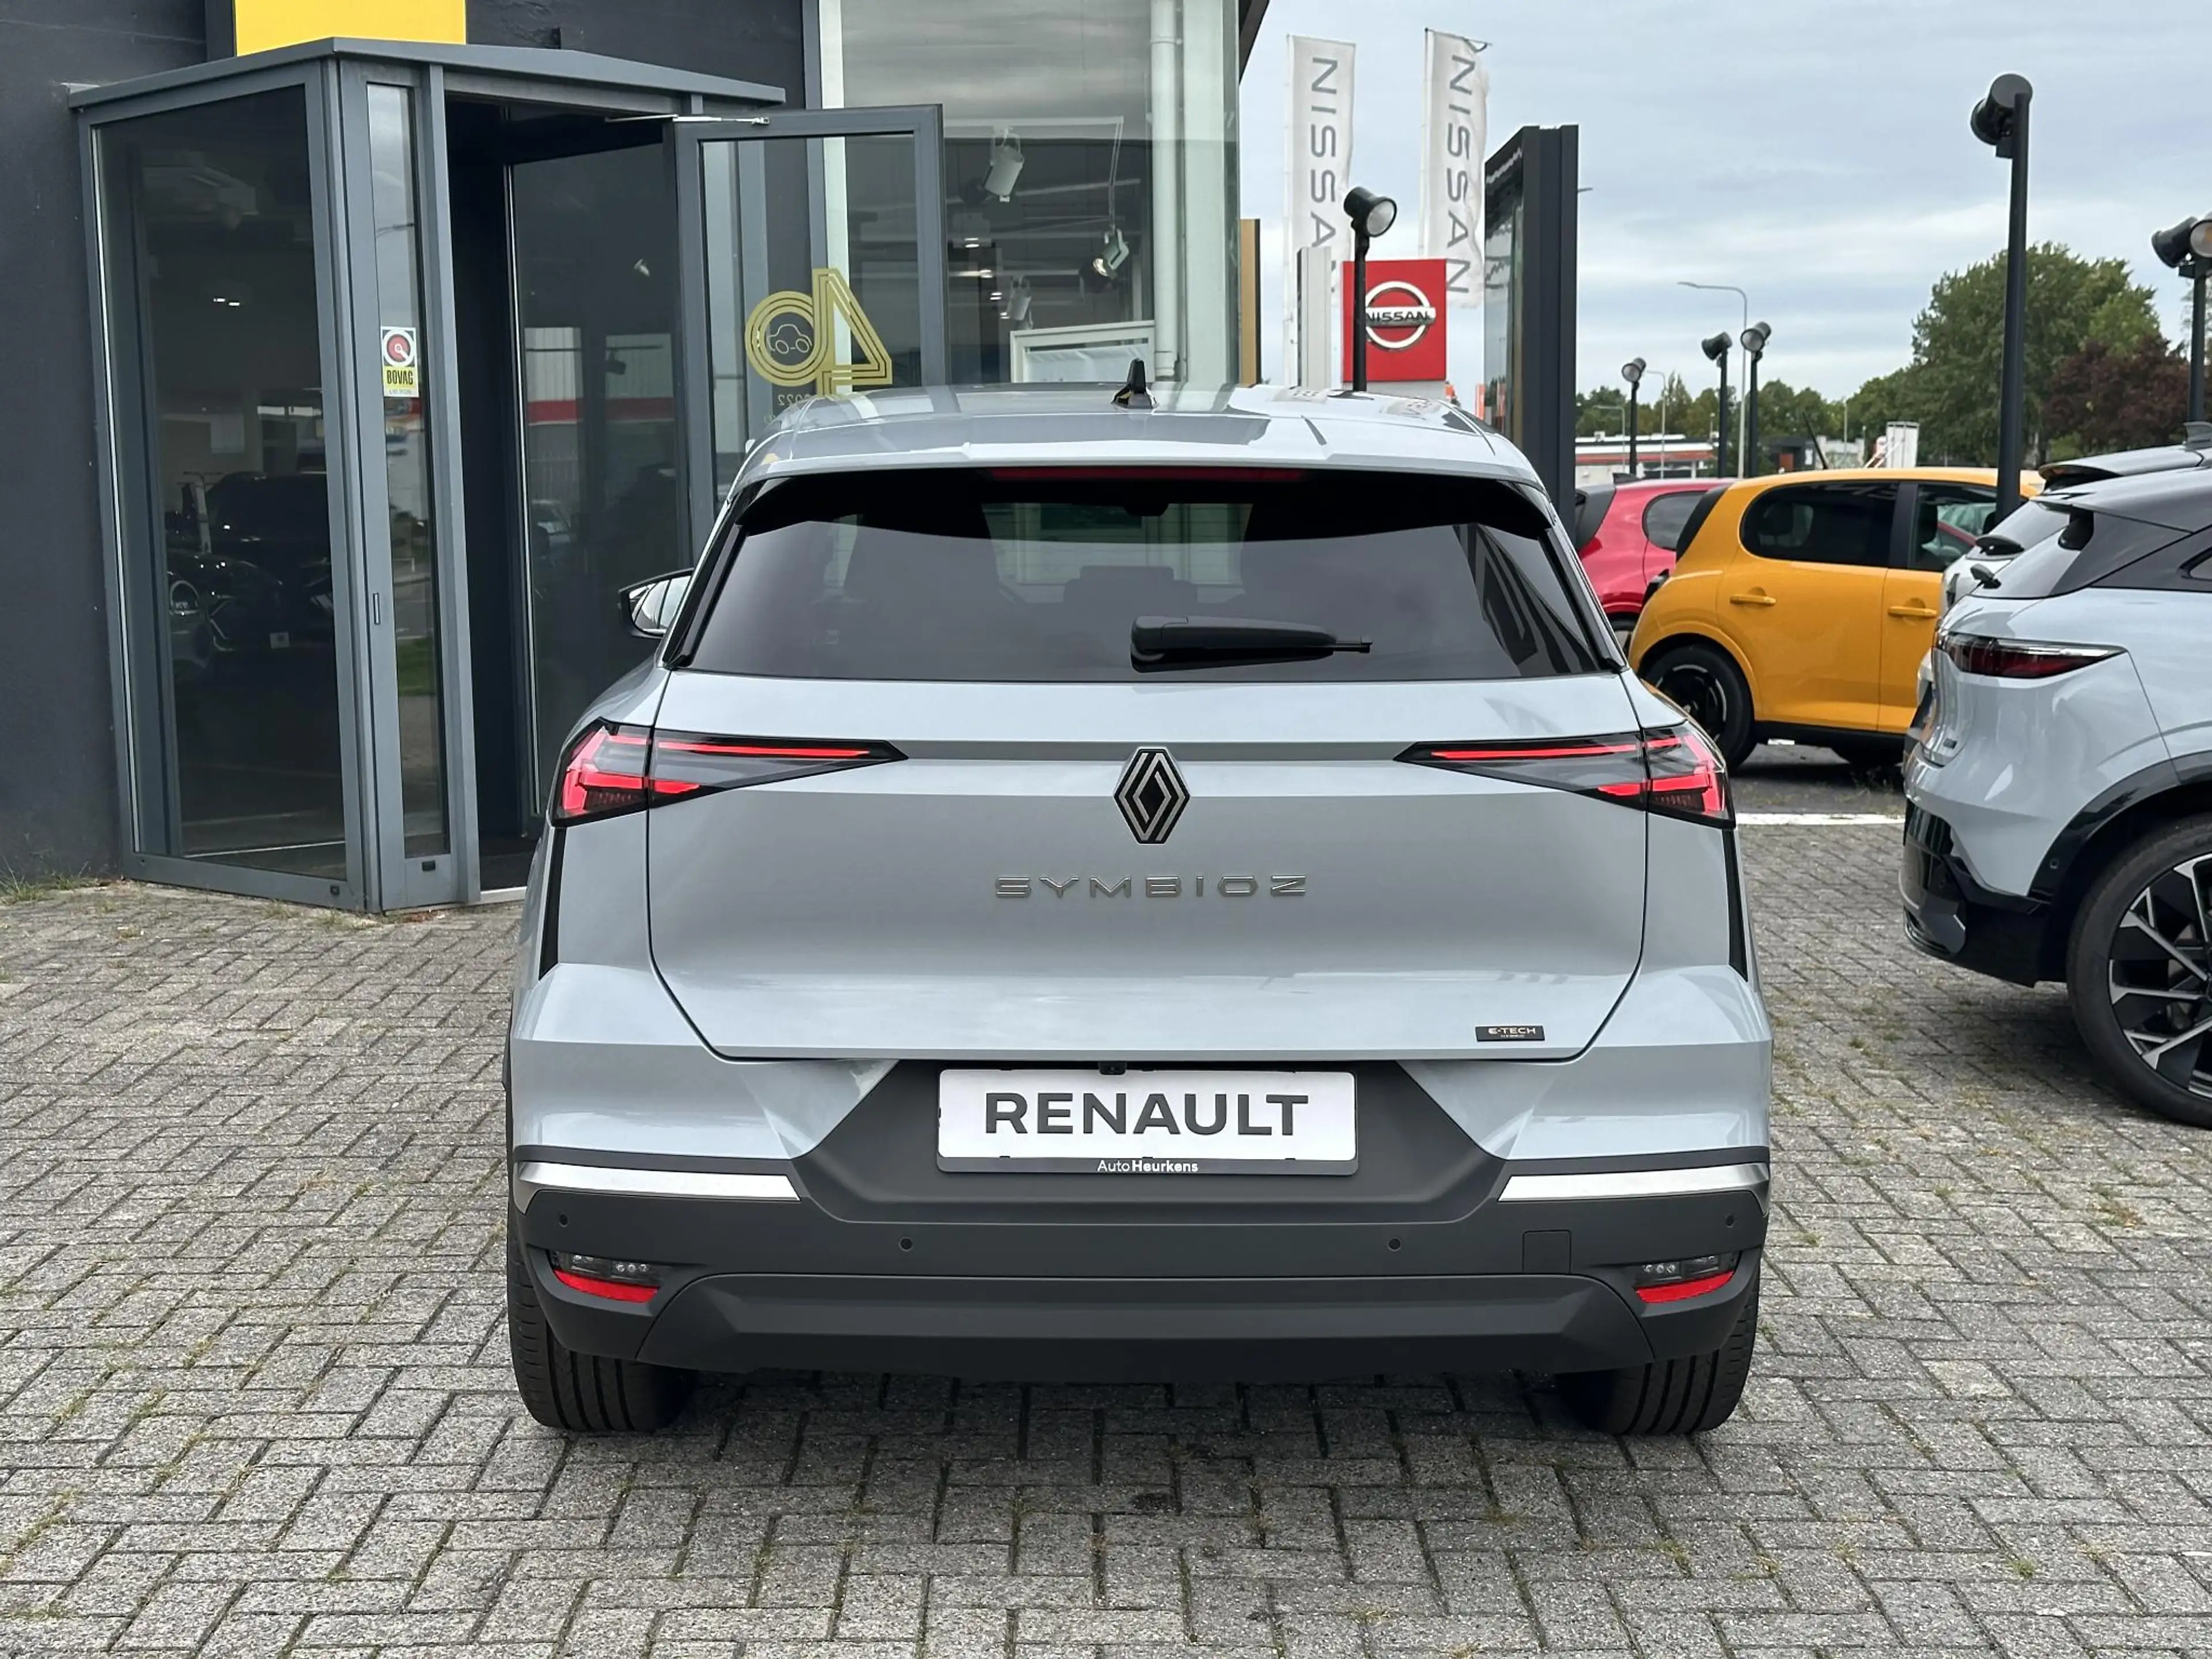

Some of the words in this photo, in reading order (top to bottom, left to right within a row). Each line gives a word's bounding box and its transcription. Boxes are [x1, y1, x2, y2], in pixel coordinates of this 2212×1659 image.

[1310, 56, 1338, 293] NISSA
[1446, 55, 1475, 293] NISSAN
[1366, 311, 1427, 322] NISSAN
[387, 370, 413, 385] BOVAG
[995, 875, 1306, 898] SYMBIOZ
[986, 1093, 1309, 1136] RENAULT
[1097, 1160, 1130, 1172] Auto
[1132, 1160, 1199, 1173] Heurkens
